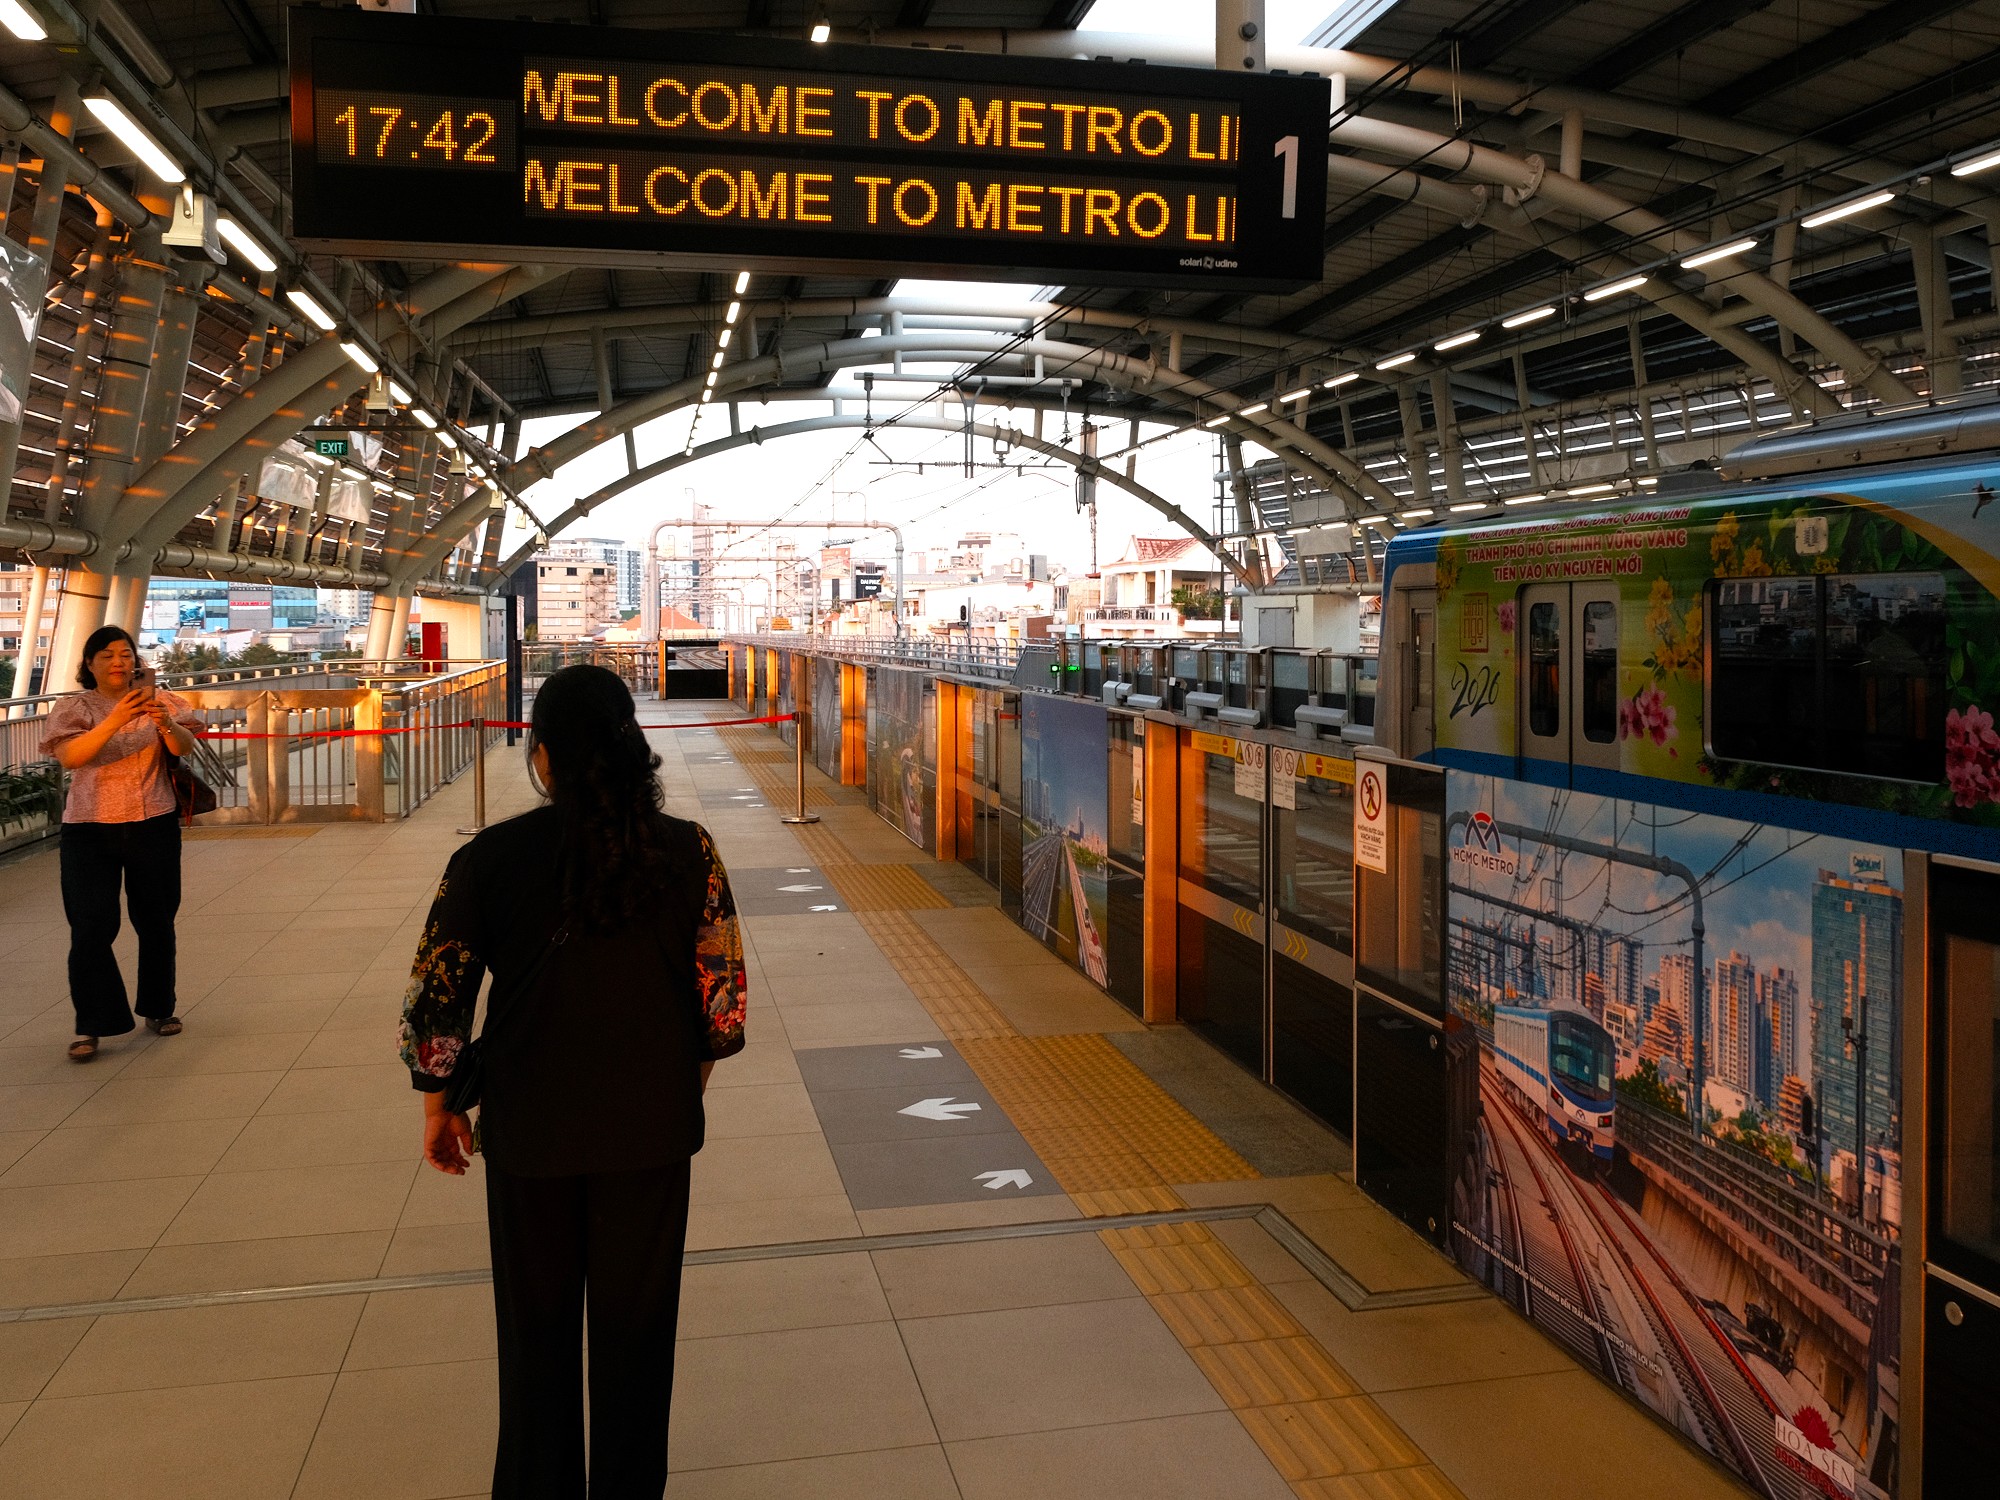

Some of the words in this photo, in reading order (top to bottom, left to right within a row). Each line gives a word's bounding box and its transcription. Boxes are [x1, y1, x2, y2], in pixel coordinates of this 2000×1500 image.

[335, 106, 496, 162] 17:42
[855, 91, 940, 142] TO
[958, 97, 1173, 156] METRO
[1188, 113, 1240, 161] LI
[1274, 135, 1299, 219] 1
[854, 176, 938, 226] TO
[956, 181, 1170, 238] METRO
[1185, 194, 1237, 242] LI
[1179, 258, 1203, 267] solari
[1215, 259, 1238, 268] udine
[320, 442, 344, 454] EXIT
[1662, 506, 1692, 520] VINH
[1466, 544, 1500, 563] THÀNH
[1502, 537, 1525, 560] PHỐ
[1528, 536, 1544, 557] HỒ
[1547, 534, 1567, 556] CHÍ
[1570, 533, 1602, 554] MINH
[1647, 526, 1687, 549] VÀNG
[1493, 561, 1517, 582] TIẾN
[1519, 560, 1542, 580] VÀO
[1563, 553, 1612, 577] NGUYÊN
[1616, 552, 1643, 575] MỚI
[1453, 848, 1479, 866] HCMC
[1481, 854, 1514, 875] METRO
[1777, 1421, 1813, 1461] HOA
[1821, 1453, 1853, 1488] SEN
